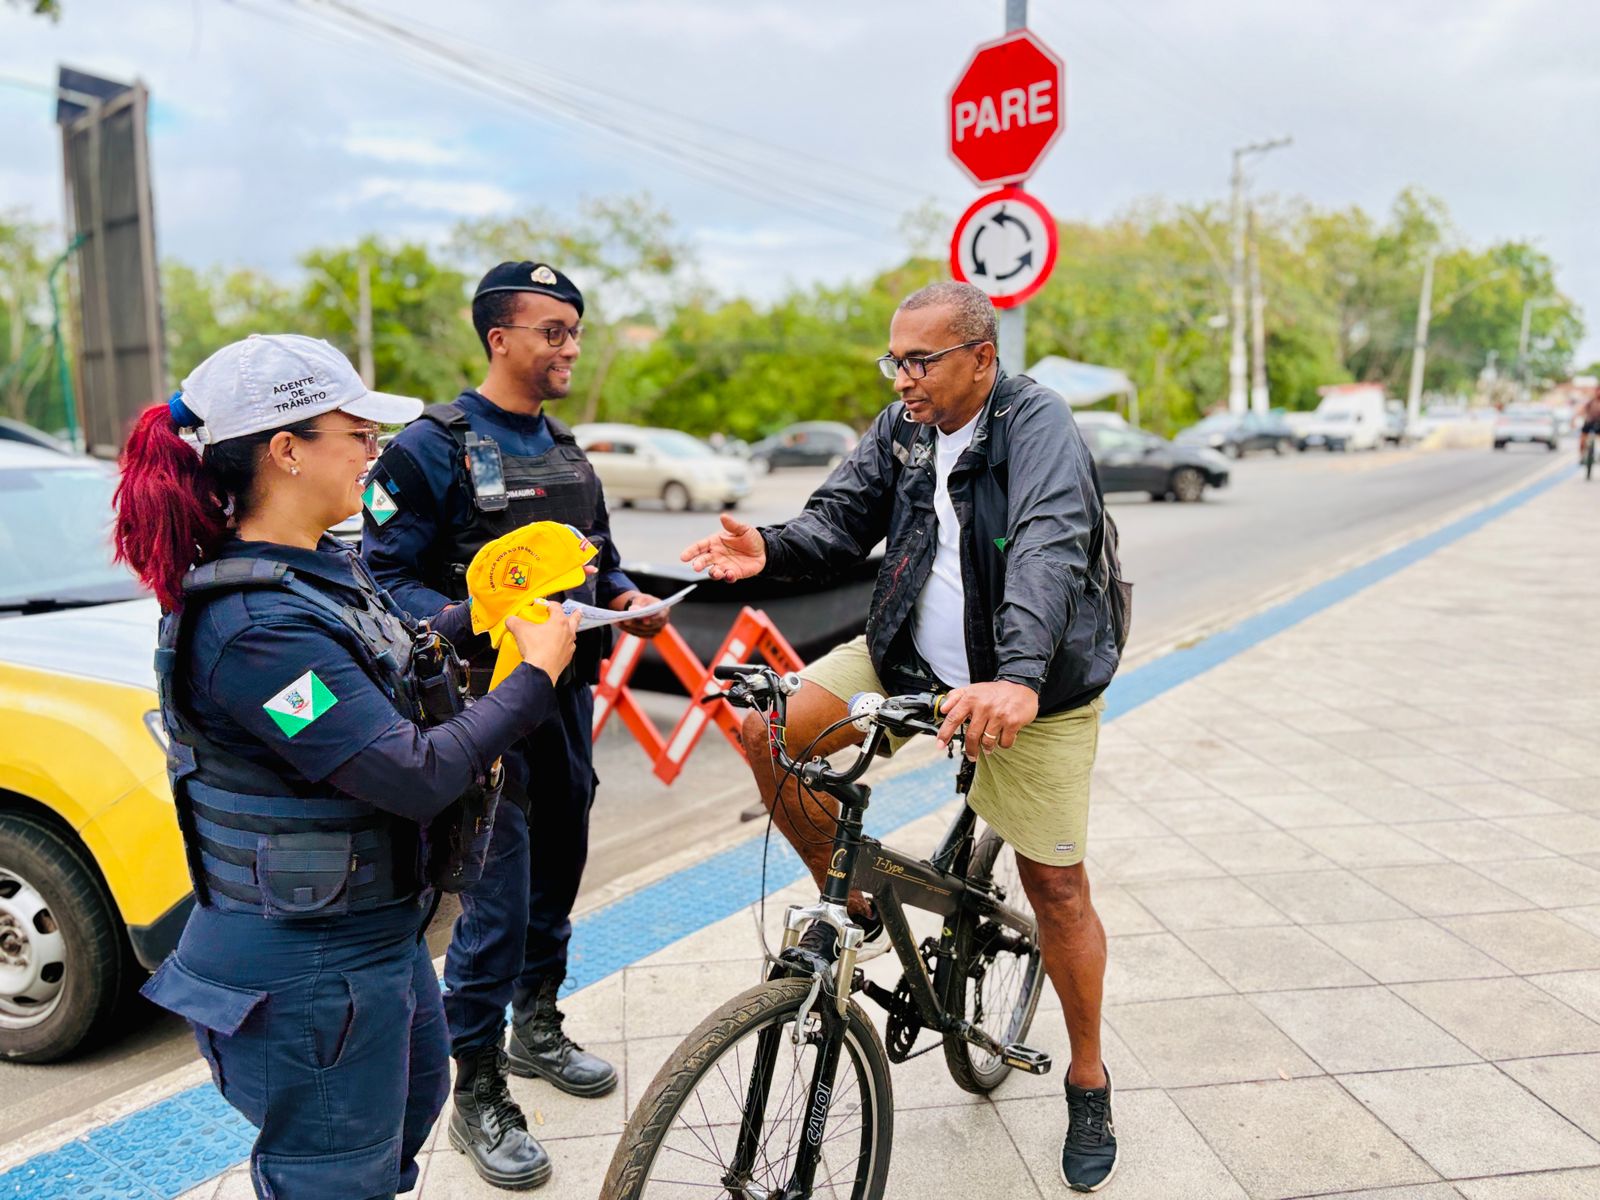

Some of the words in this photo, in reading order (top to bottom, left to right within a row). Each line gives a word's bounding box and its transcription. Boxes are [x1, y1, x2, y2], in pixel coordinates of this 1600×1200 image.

[955, 80, 1054, 142] PARE
[273, 376, 315, 395] AGENTE
[291, 388, 306, 399] DE
[274, 391, 326, 413] TRÂNSITO
[875, 856, 905, 874] T-Type
[807, 1081, 831, 1146] CALOI
